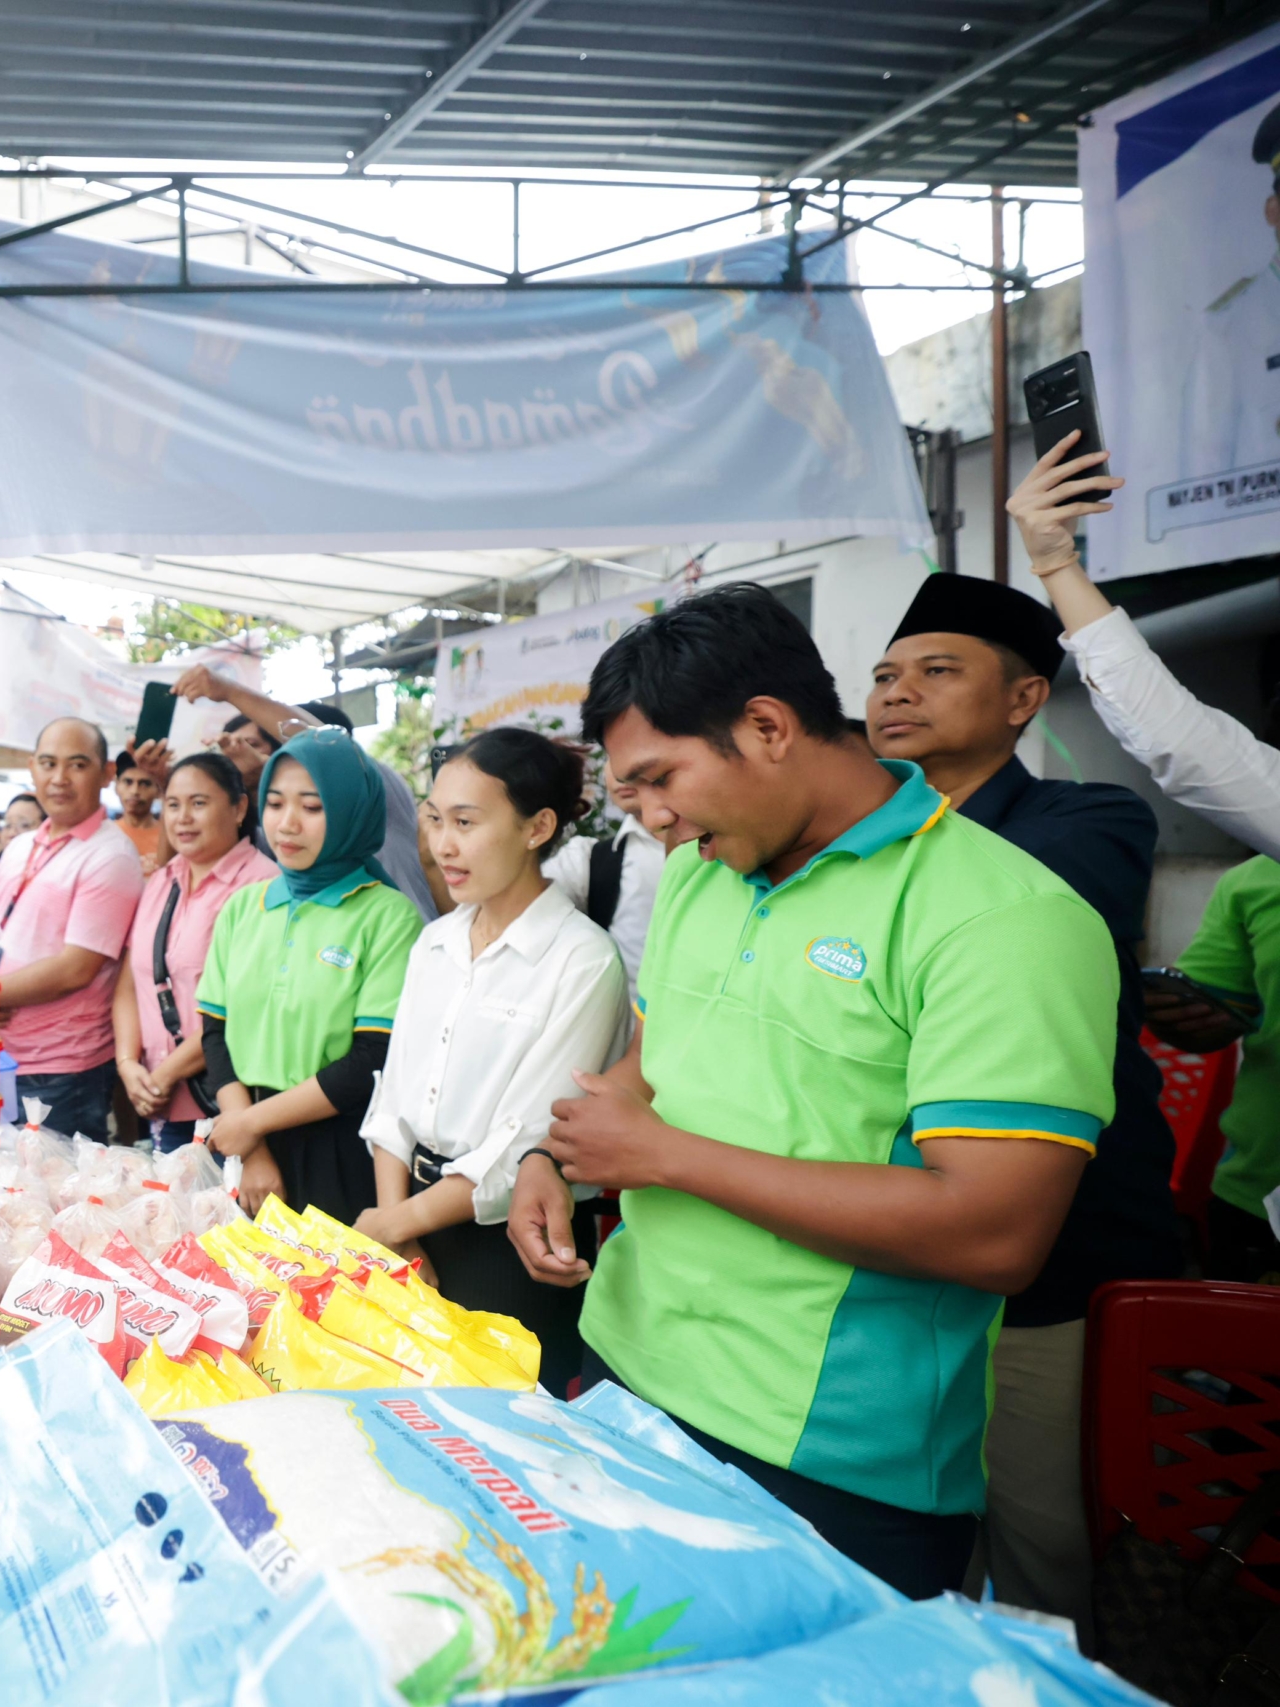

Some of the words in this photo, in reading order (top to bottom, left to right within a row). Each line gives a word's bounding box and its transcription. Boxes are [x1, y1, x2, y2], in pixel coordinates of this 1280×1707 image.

[812, 945, 863, 973] prima
[14, 1279, 105, 1328] AKUMO
[377, 1399, 441, 1431] Dua
[427, 1436, 570, 1533] Merpati
